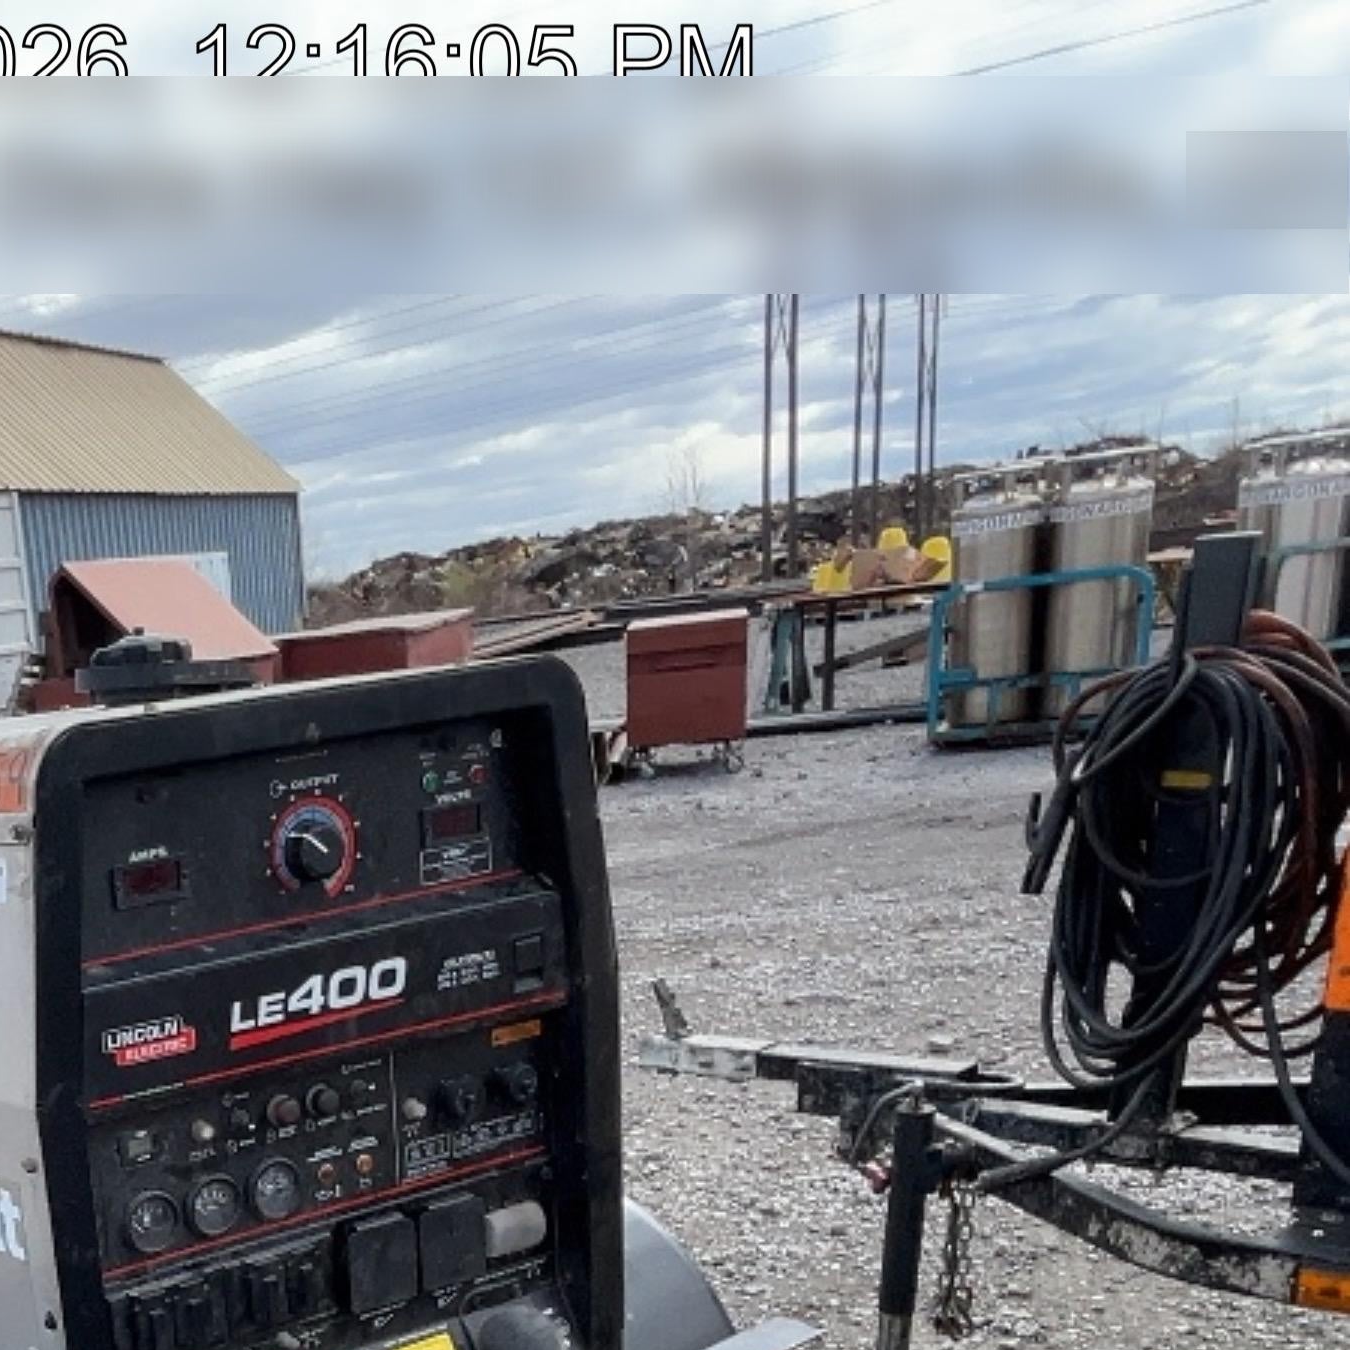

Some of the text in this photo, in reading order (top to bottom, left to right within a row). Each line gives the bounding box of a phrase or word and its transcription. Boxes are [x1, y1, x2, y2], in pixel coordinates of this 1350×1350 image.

[290, 773, 340, 791] OUTPUT
[230, 956, 408, 1034] LE400
[106, 1020, 179, 1049] LINCOLN
[125, 1037, 187, 1061] ELECTRIC
